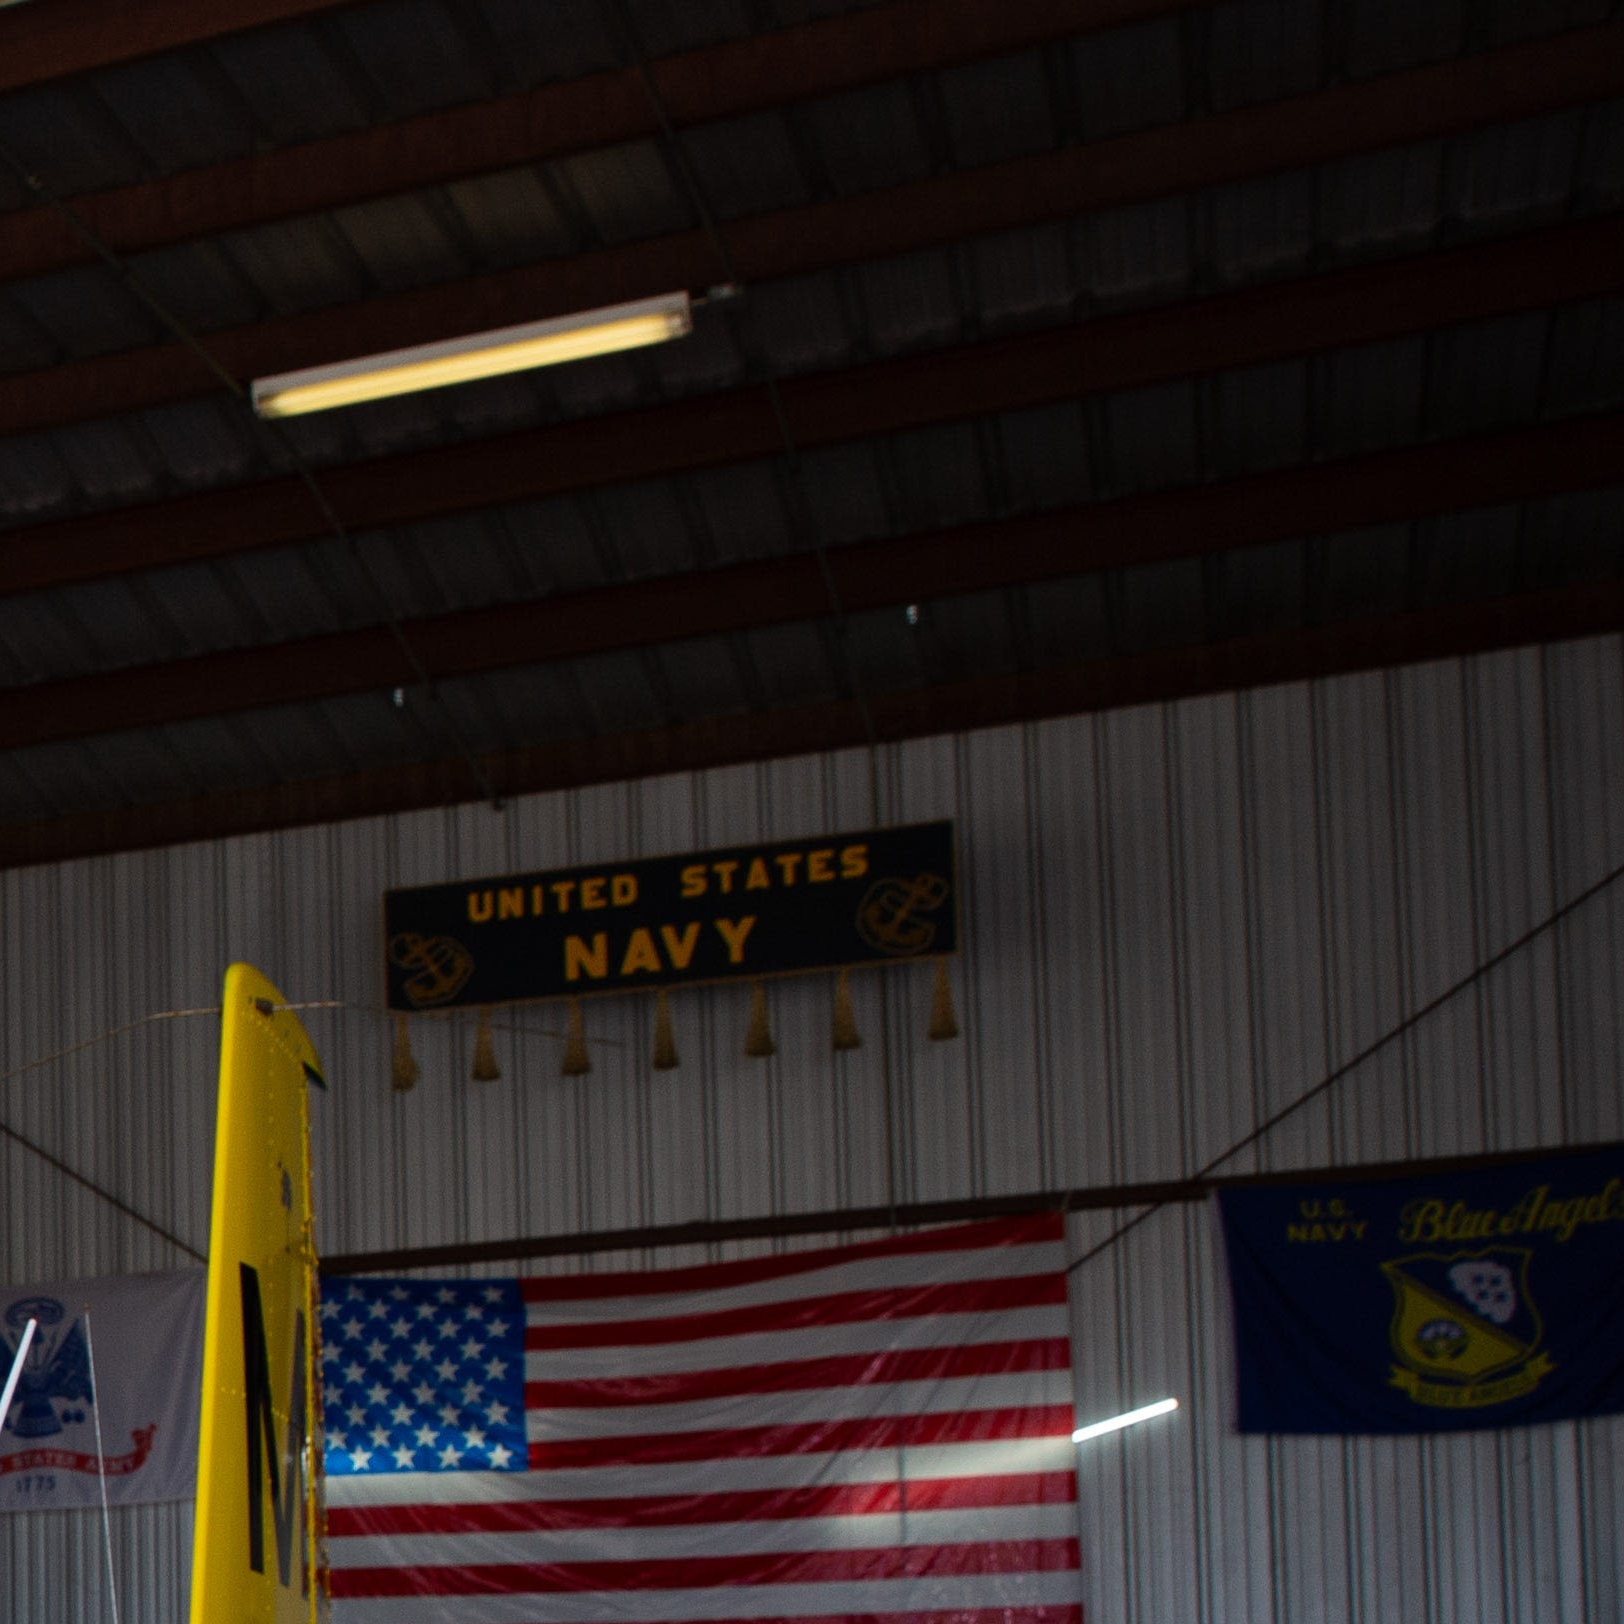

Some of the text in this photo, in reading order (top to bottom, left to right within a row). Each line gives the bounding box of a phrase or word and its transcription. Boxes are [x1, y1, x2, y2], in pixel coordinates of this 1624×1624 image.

[466, 843, 869, 922] UNITED STATES
[562, 915, 756, 982] NAVY
[1287, 1221, 1368, 1242] NAVY
[1399, 1198, 1498, 1243] Blue
